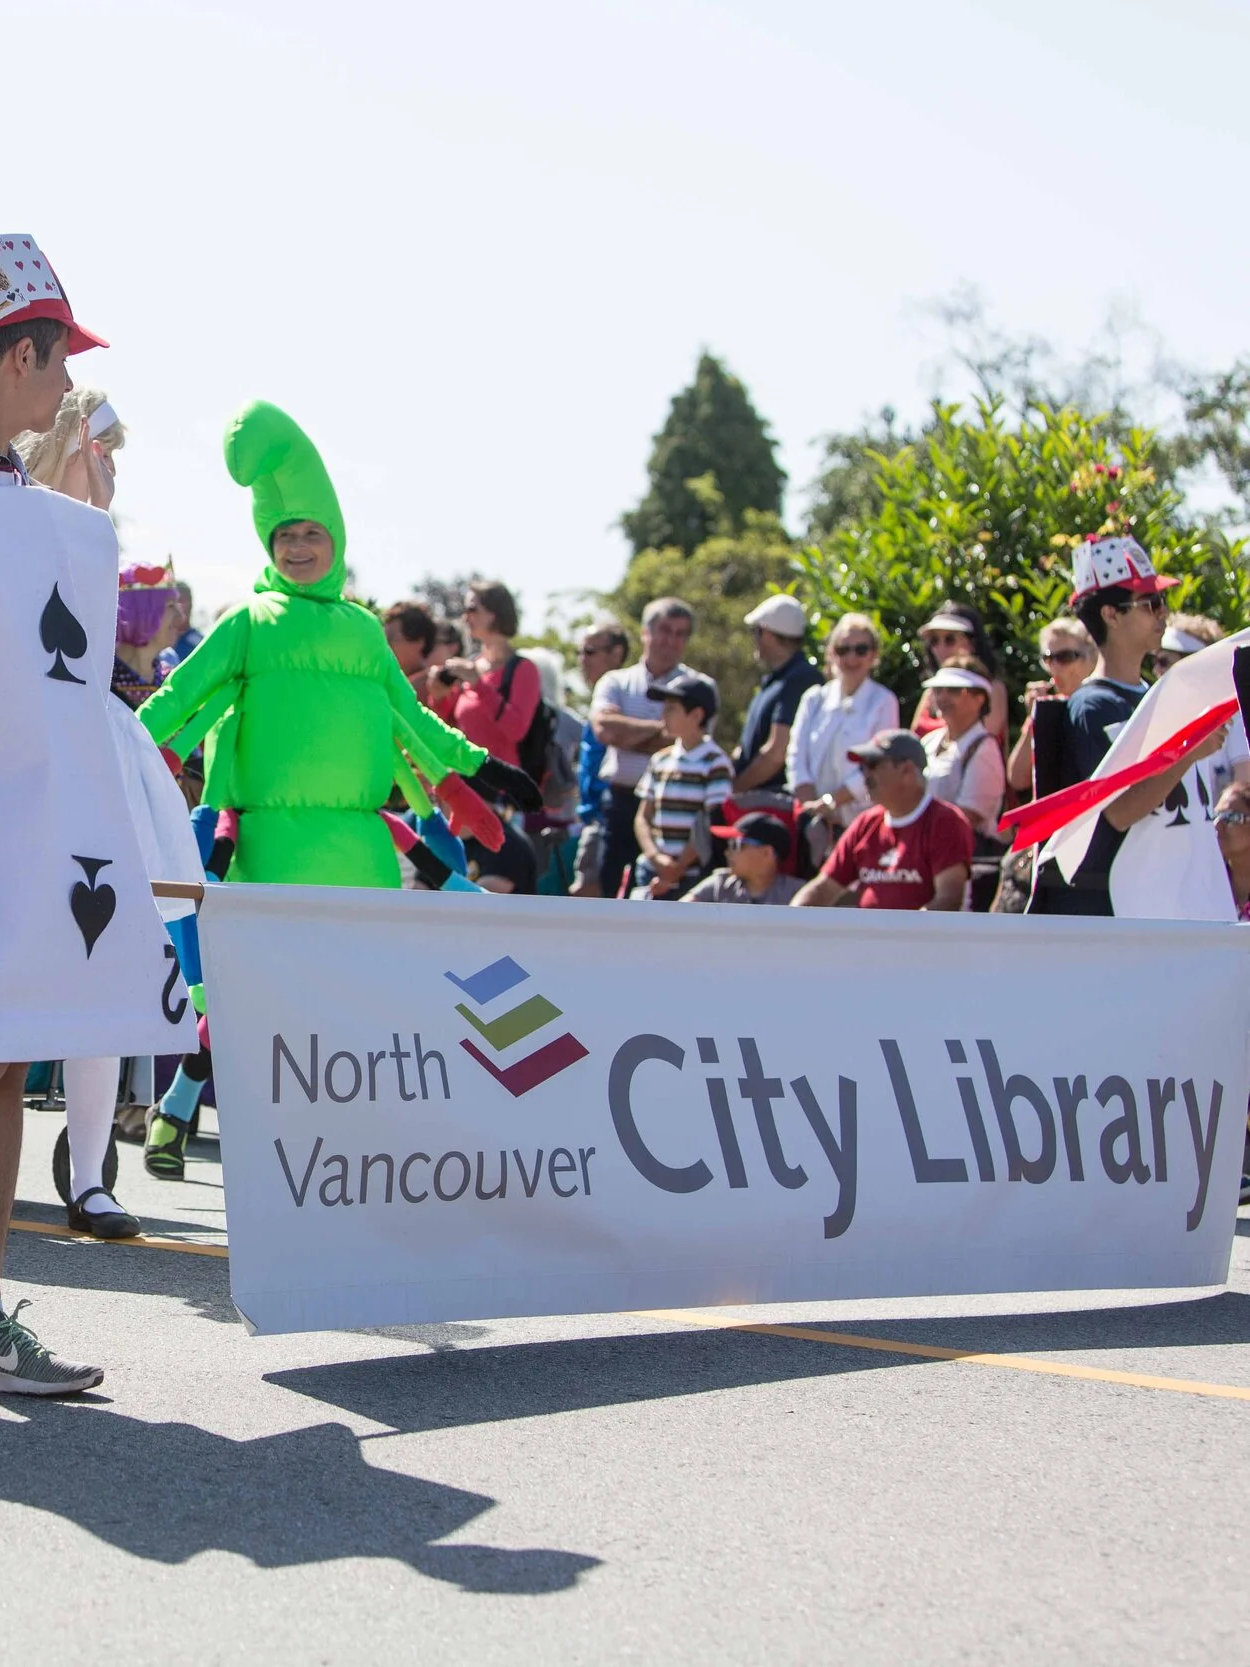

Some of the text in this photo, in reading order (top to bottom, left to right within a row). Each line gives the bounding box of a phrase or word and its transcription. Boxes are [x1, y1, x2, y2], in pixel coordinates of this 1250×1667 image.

[161, 944, 188, 1025] 2
[271, 1031, 452, 1105] North
[272, 1135, 597, 1209] Vancouver
[607, 1032, 1225, 1240] City Library
